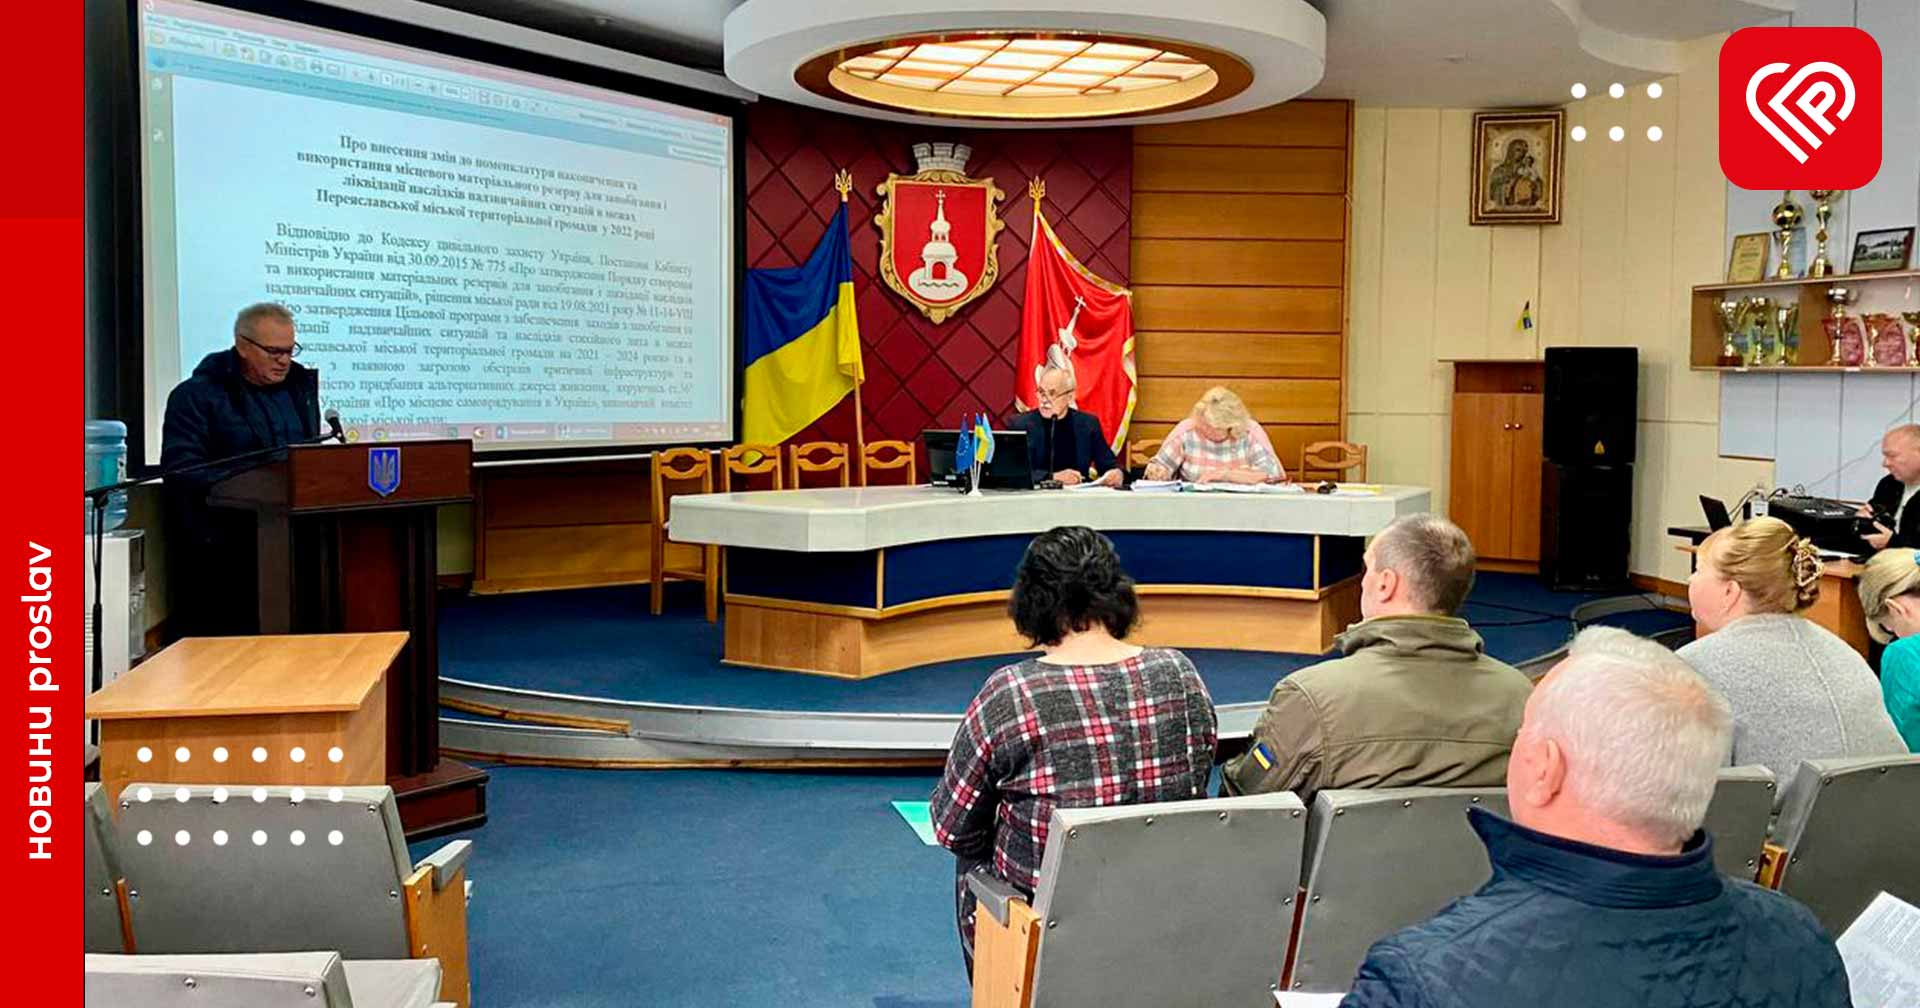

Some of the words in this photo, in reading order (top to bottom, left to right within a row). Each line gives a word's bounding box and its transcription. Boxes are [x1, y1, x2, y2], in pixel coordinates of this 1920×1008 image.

[296, 151, 392, 173] використання
[395, 161, 455, 181] місцевого
[457, 172, 540, 193] матеріального
[340, 135, 367, 153] Про
[371, 142, 428, 160] внесення
[430, 150, 456, 164] змін
[459, 155, 472, 167] до
[475, 157, 555, 180] номенклатури
[342, 173, 406, 194] ліквідації
[409, 183, 466, 200] наслідків
[468, 190, 547, 211] надзвичайних
[549, 200, 595, 217] ситуацій
[316, 187, 420, 213] Переяславської
[422, 201, 466, 218] міської
[467, 209, 553, 229] територіальної
[554, 218, 598, 234] громади
[610, 223, 633, 239] 2022
[276, 221, 351, 242] Відповідно
[357, 233, 374, 245] до
[380, 231, 431, 252] Кодексу
[437, 238, 499, 255] цивільного
[264, 239, 330, 261] Міністрів
[332, 245, 384, 265] України
[386, 250, 405, 266] від
[408, 252, 468, 270] 30.09.2015
[486, 258, 506, 273] 775
[508, 261, 536, 278] «Про
[264, 263, 280, 275] та
[286, 264, 375, 282] використання
[380, 270, 459, 288] матеріальних
[265, 282, 357, 299] надзвичайних
[304, 304, 393, 319] затвердження
[395, 305, 446, 323] Цільової
[448, 310, 502, 325] програми
[348, 324, 433, 338] надзвичайних
[440, 326, 488, 342] ситуацій
[373, 340, 417, 355] міської
[423, 343, 506, 359] територіальної
[511, 347, 556, 361] громади
[360, 377, 424, 394] придбання
